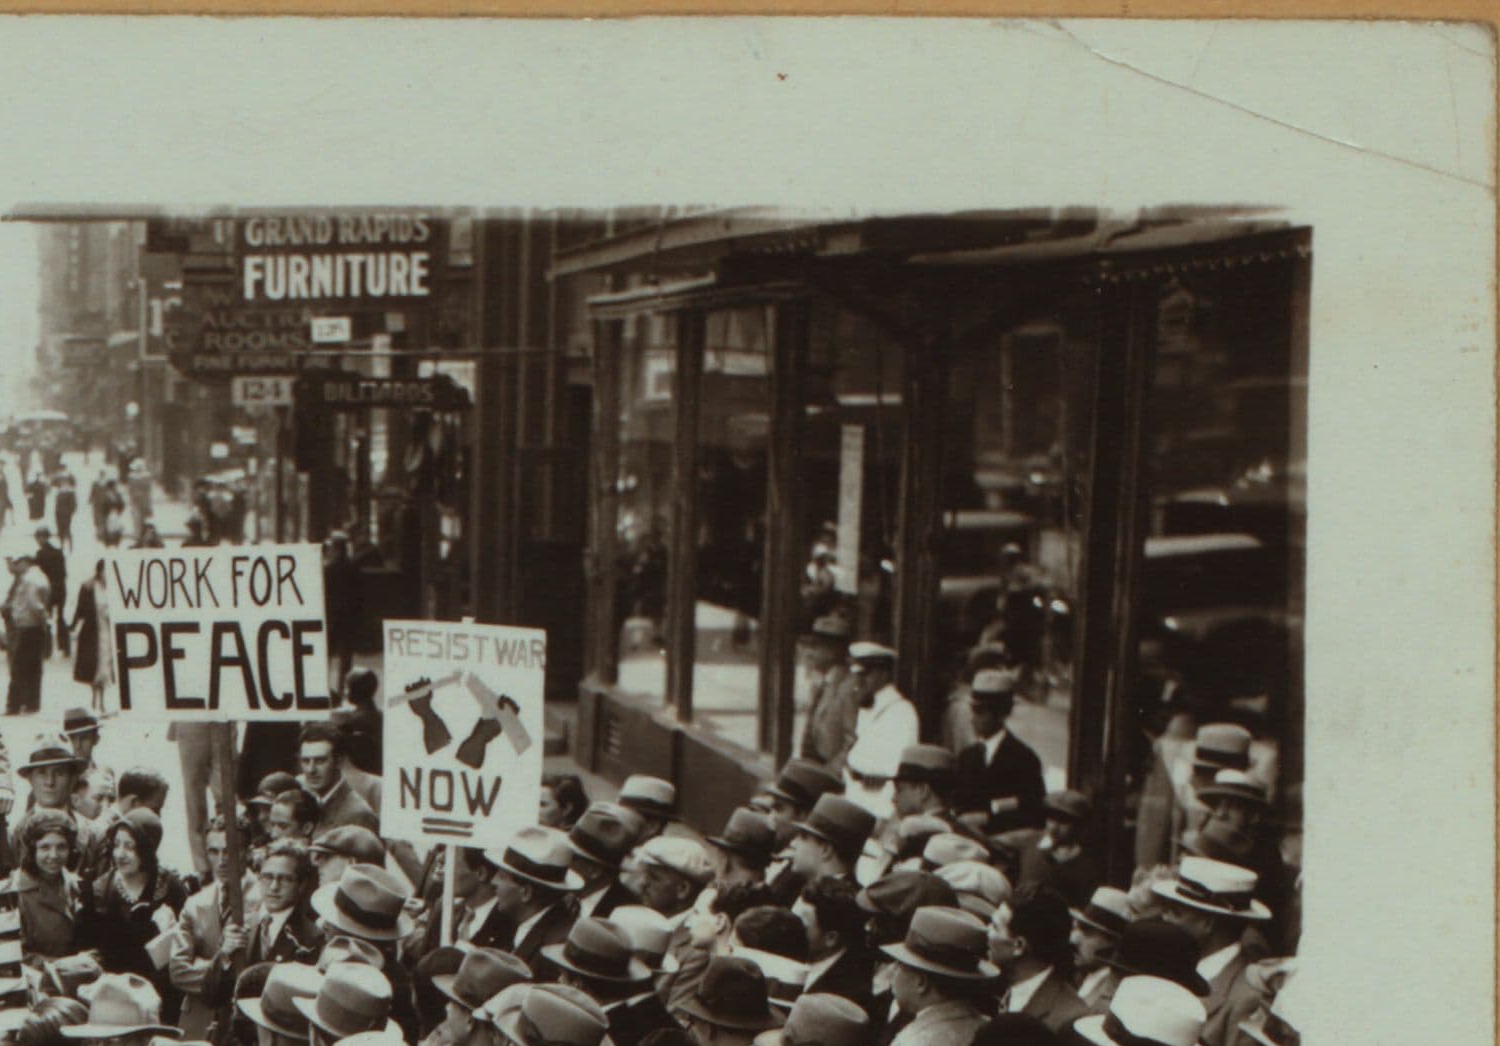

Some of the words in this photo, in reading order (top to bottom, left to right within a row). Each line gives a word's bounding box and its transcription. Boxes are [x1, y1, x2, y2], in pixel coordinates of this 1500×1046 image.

[244, 218, 333, 246] GRAND
[339, 214, 430, 243] RAPIDS
[244, 253, 430, 300] FURNITURE
[112, 557, 219, 609] WORK
[231, 554, 304, 607] FOR
[114, 619, 331, 711] PEACE
[388, 626, 490, 664] RESIST
[494, 636, 548, 671] WAR
[400, 767, 503, 818] NOW
